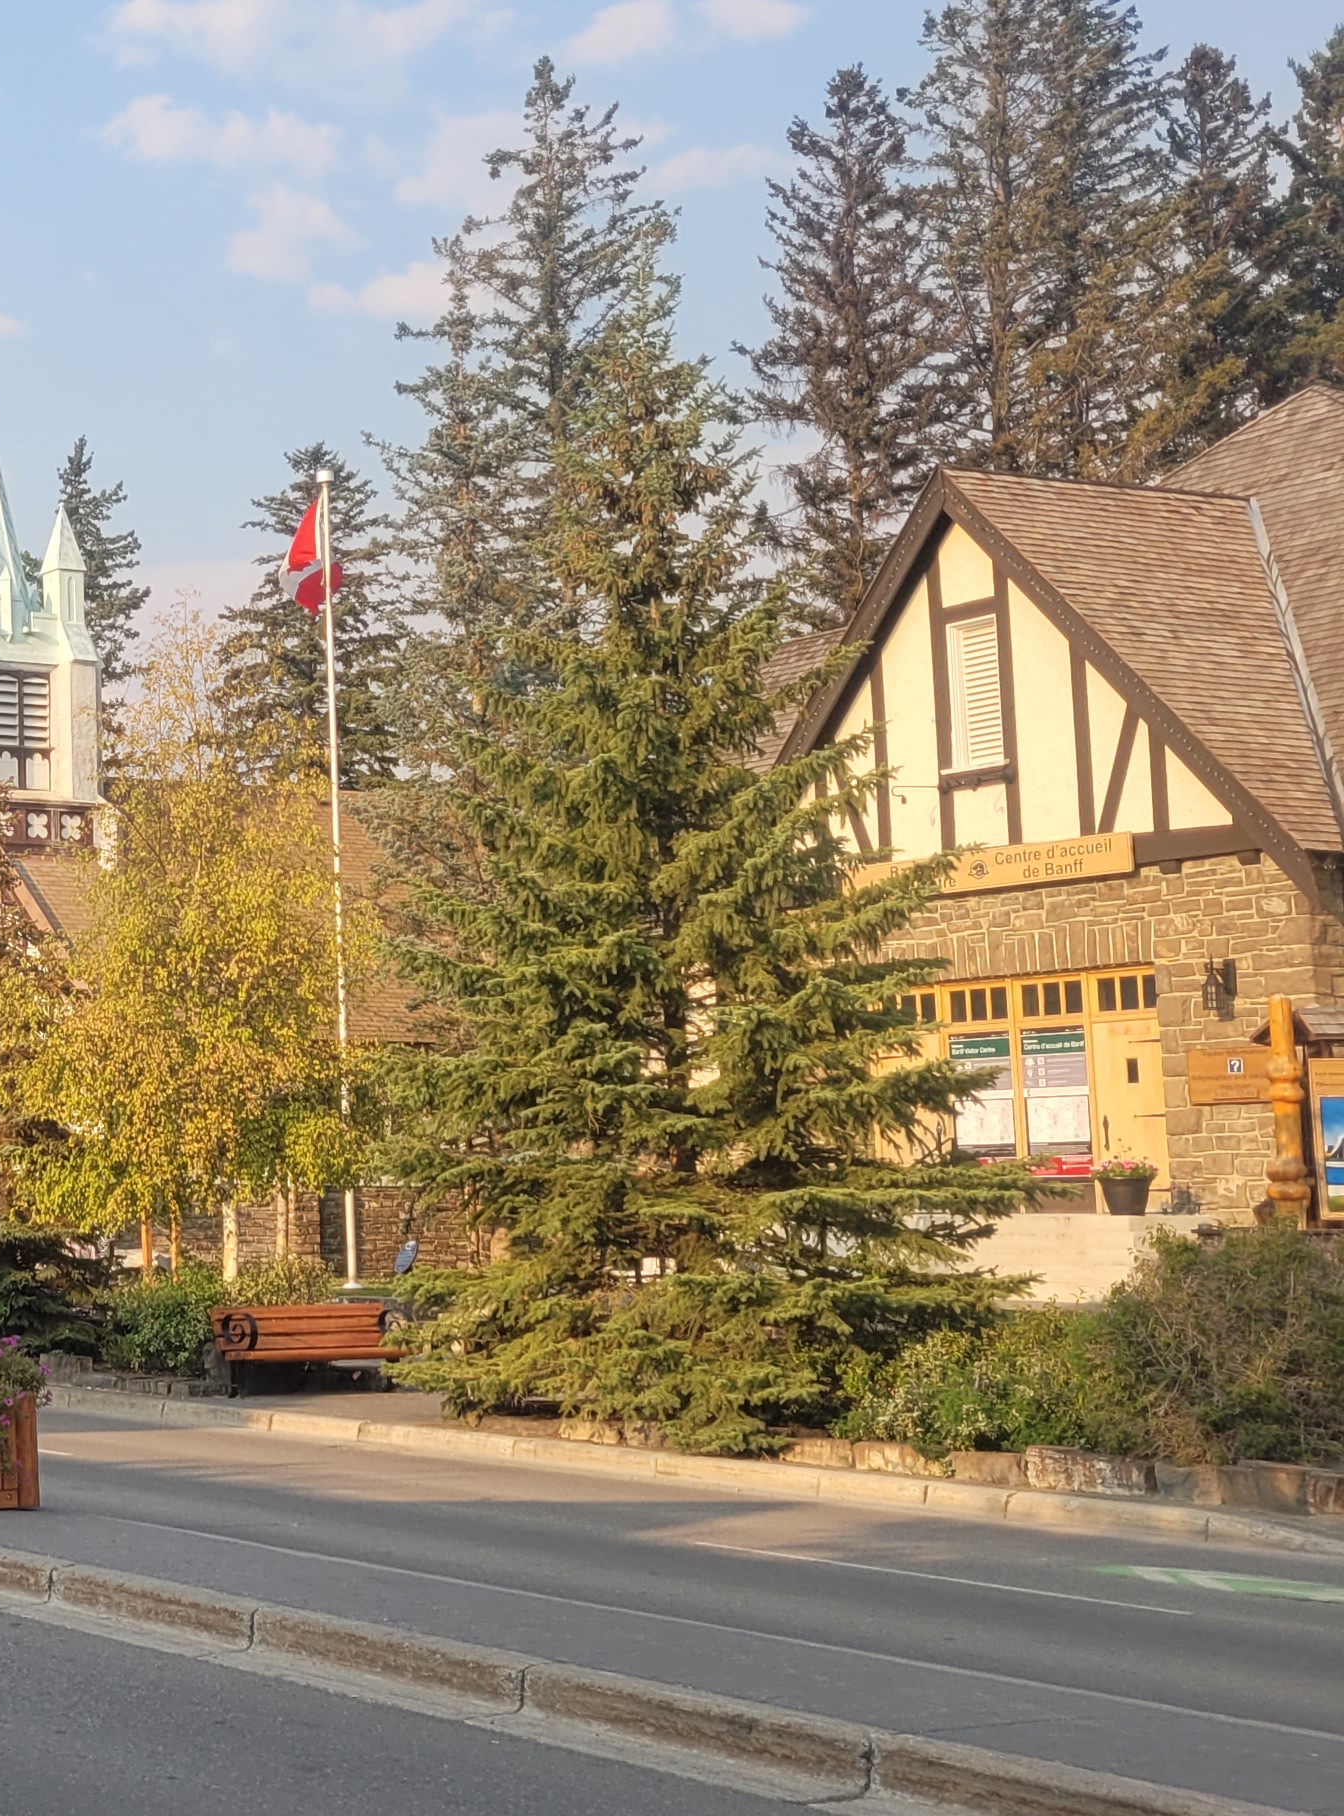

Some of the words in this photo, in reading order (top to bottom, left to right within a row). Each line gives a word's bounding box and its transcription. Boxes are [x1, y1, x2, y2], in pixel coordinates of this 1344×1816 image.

[995, 850, 1041, 865] Centre
[1047, 838, 1112, 859] d'accueil
[1023, 865, 1040, 878] de
[1045, 859, 1083, 876] Banff
